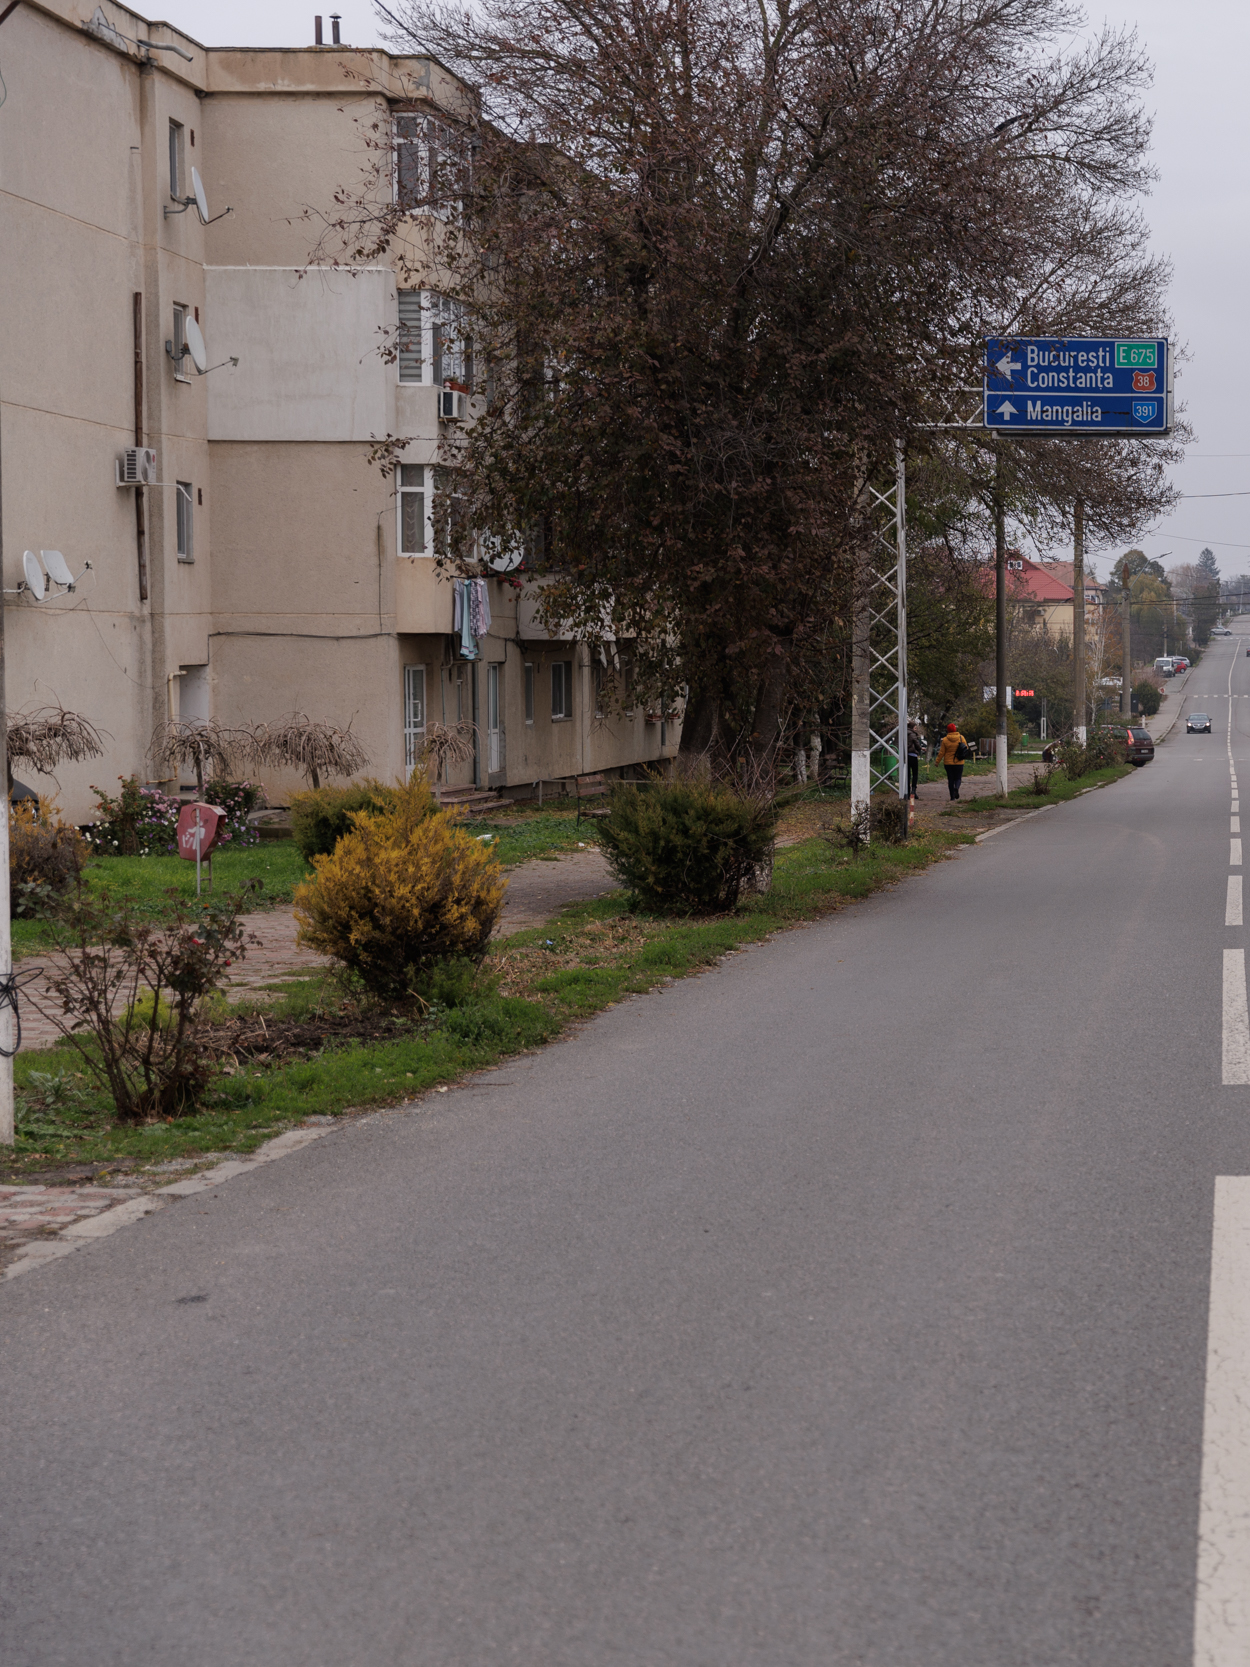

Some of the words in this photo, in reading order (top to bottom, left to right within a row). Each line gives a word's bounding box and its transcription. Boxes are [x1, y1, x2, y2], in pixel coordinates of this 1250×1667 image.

[1027, 345, 1110, 370] București
[1119, 346, 1128, 363] E
[1130, 349, 1154, 363] 675
[1027, 367, 1114, 390] Constanța
[1137, 375, 1150, 387] 38
[1027, 400, 1102, 426] Mangalia
[1136, 405, 1153, 417] 391
